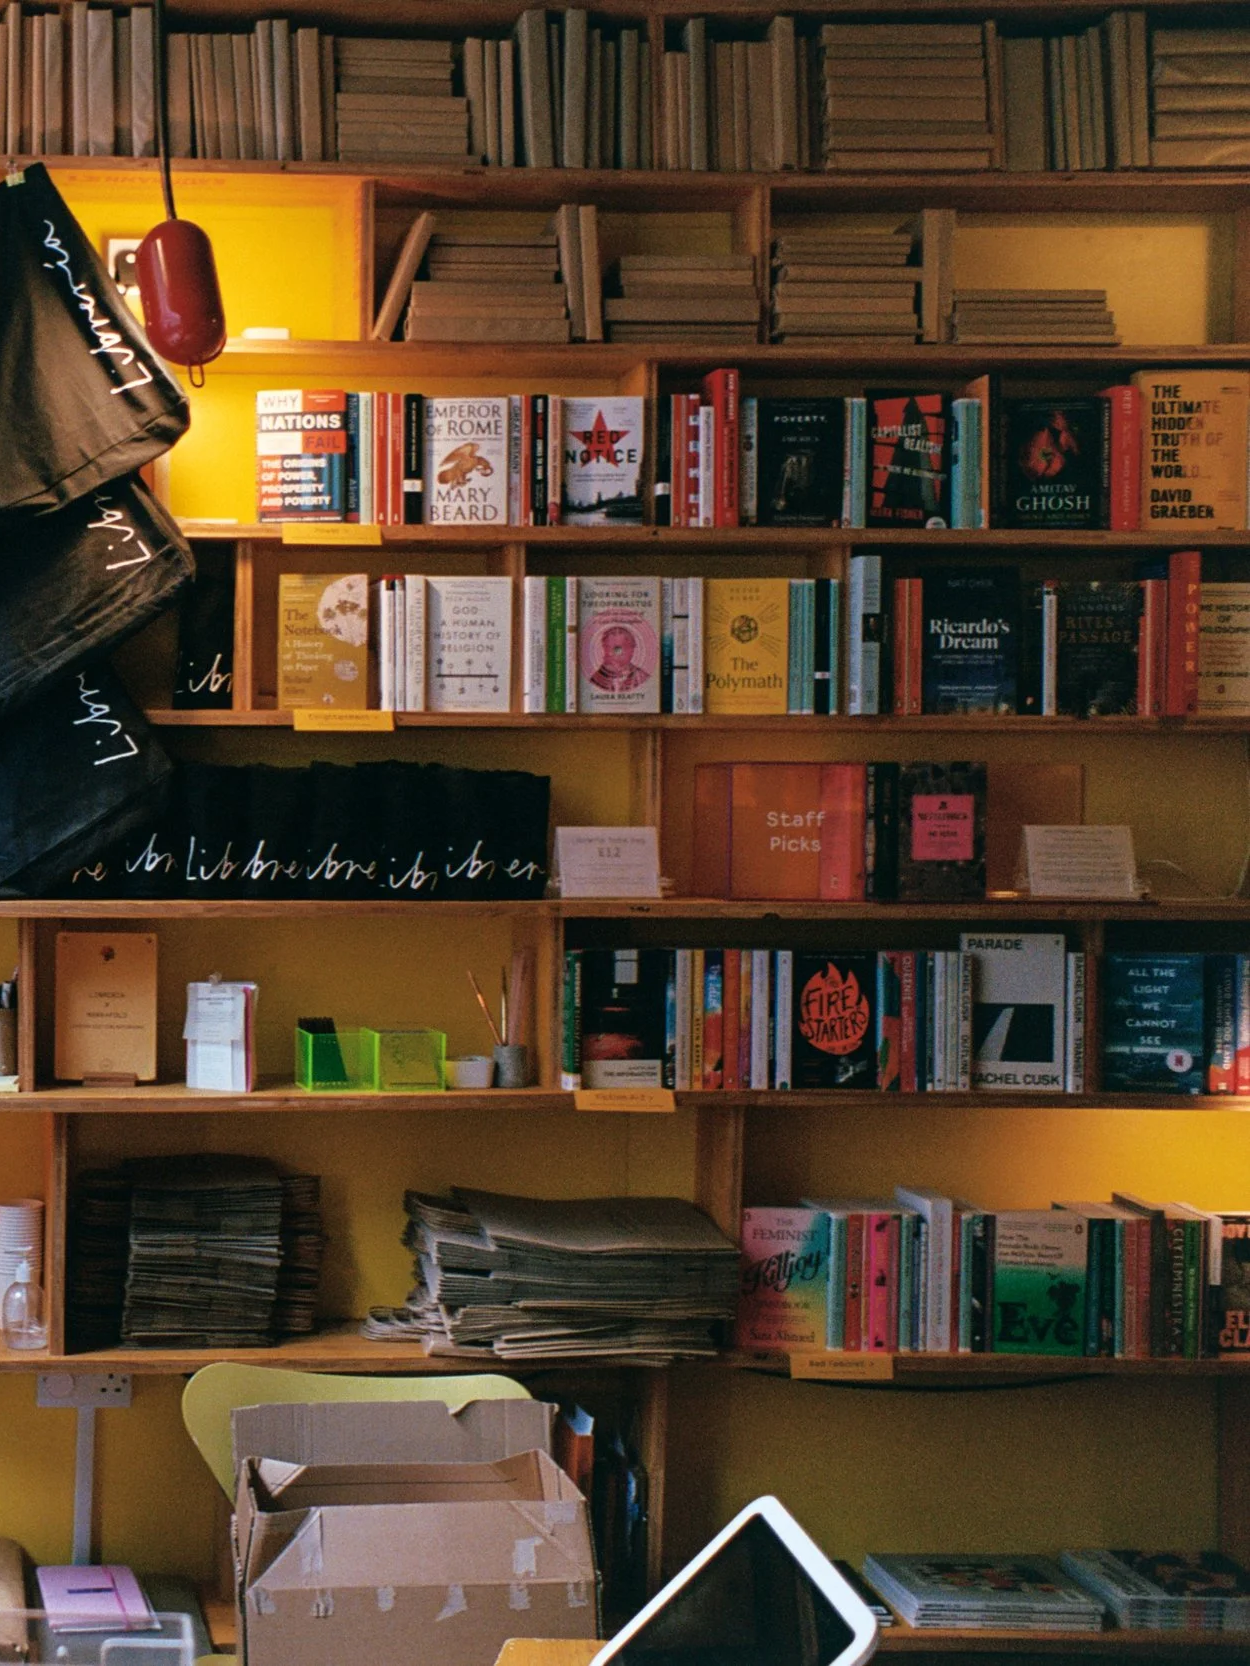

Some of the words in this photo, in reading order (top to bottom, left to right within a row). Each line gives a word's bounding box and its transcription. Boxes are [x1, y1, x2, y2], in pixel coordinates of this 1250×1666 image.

[1151, 384, 1181, 399] THE
[261, 394, 299, 409] WHY
[1151, 400, 1222, 415] ULTIMATE
[426, 404, 503, 419] EMPEROR
[260, 414, 342, 431] NATIONS
[426, 423, 443, 437] OF
[447, 420, 503, 436] ROME
[1151, 416, 1205, 431] HIDDEN
[304, 435, 341, 450] FAIL
[582, 429, 621, 444] RED
[1151, 432, 1200, 447] TRUTH
[261, 458, 282, 469] THE
[283, 457, 327, 469] ORIGINS
[565, 448, 638, 465] NOTICE
[1151, 449, 1181, 463] THE
[261, 471, 276, 482] OF
[261, 483, 324, 495] PROSPERITY
[436, 487, 491, 503] MARY
[1151, 489, 1193, 504] DAVID
[261, 496, 284, 508] AND
[284, 495, 332, 507] POVERTY
[1016, 495, 1091, 512] GHOSH
[430, 505, 499, 521] BEARD
[1151, 504, 1216, 520] GRAEBER
[284, 608, 309, 621] The
[452, 606, 479, 615] GOD
[283, 622, 343, 637] Notebook
[452, 619, 495, 628] HUMAN
[929, 618, 1010, 635] Ricardo's
[1185, 583, 1198, 673] POWER
[433, 631, 481, 640] HISTORY
[486, 631, 501, 640] OF
[939, 633, 1000, 650] Dream
[292, 639, 325, 652] History
[440, 644, 495, 653] RELIGION
[295, 662, 319, 674] Paper
[730, 657, 759, 672] The
[706, 673, 783, 692] Polymath
[766, 811, 826, 827] Staff
[769, 837, 822, 853] Picks
[967, 938, 1023, 950] PARADE
[1074, 955, 1084, 993] RACHEL
[1127, 968, 1149, 978] ALL
[1152, 968, 1177, 978] THE
[1133, 985, 1170, 995] LIGHT
[804, 985, 859, 1018] FIRE
[1141, 1001, 1160, 1011] WE
[1074, 996, 1084, 1023] CUSK
[805, 1008, 869, 1043] STARTERS
[1125, 1018, 1178, 1030] CANNOT
[1139, 1035, 1162, 1046] SEE
[1074, 1037, 1084, 1079] TRANSIT
[1023, 1074, 1060, 1086] CUSK
[752, 1229, 819, 1242] FEMINIST
[742, 1250, 822, 1294] Killjoy
[1171, 1228, 1185, 1337] CLYTEMNESTRA
[997, 1300, 1079, 1346] Eve
